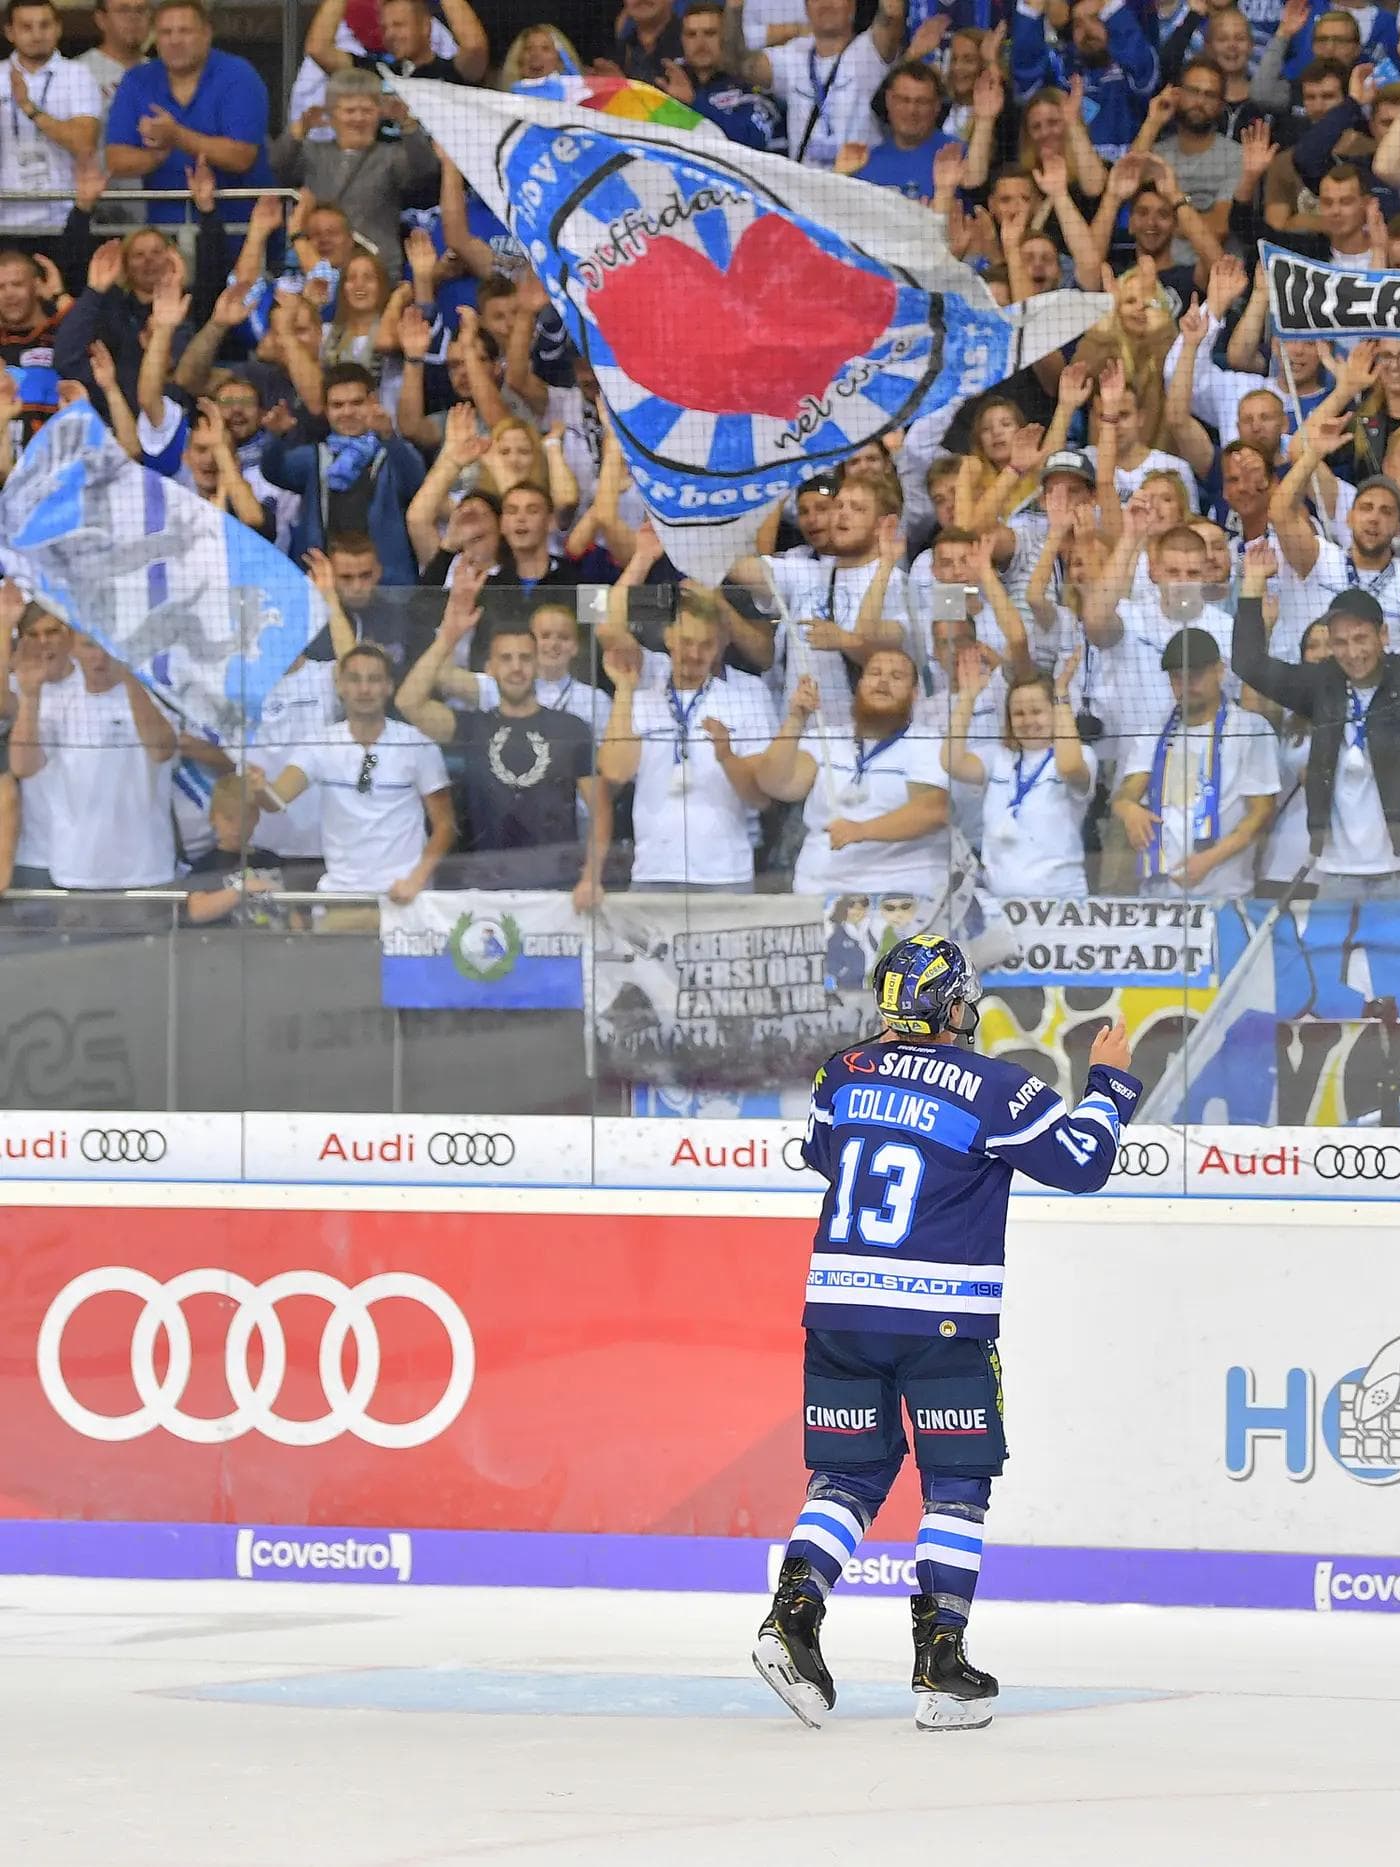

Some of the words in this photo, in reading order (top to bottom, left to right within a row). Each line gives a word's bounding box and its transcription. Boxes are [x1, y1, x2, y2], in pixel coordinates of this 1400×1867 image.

[988, 944, 1203, 972] GOLSTADT
[878, 1050, 983, 1102] SATURN
[847, 1088, 939, 1133] COLLINS
[1007, 1075, 1047, 1121] AIRB
[0, 1135, 67, 1159] udi
[319, 1132, 415, 1162] Audi
[671, 1138, 768, 1168] Audi
[1199, 1145, 1300, 1176] Audi
[828, 1137, 925, 1249] 13
[826, 1271, 962, 1295] INGOLSTADT
[970, 1283, 1003, 1296] 196
[806, 1405, 877, 1430] CINQUE
[917, 1408, 988, 1430] CINQUE
[253, 1539, 389, 1571] covestro
[842, 1554, 918, 1586] estro
